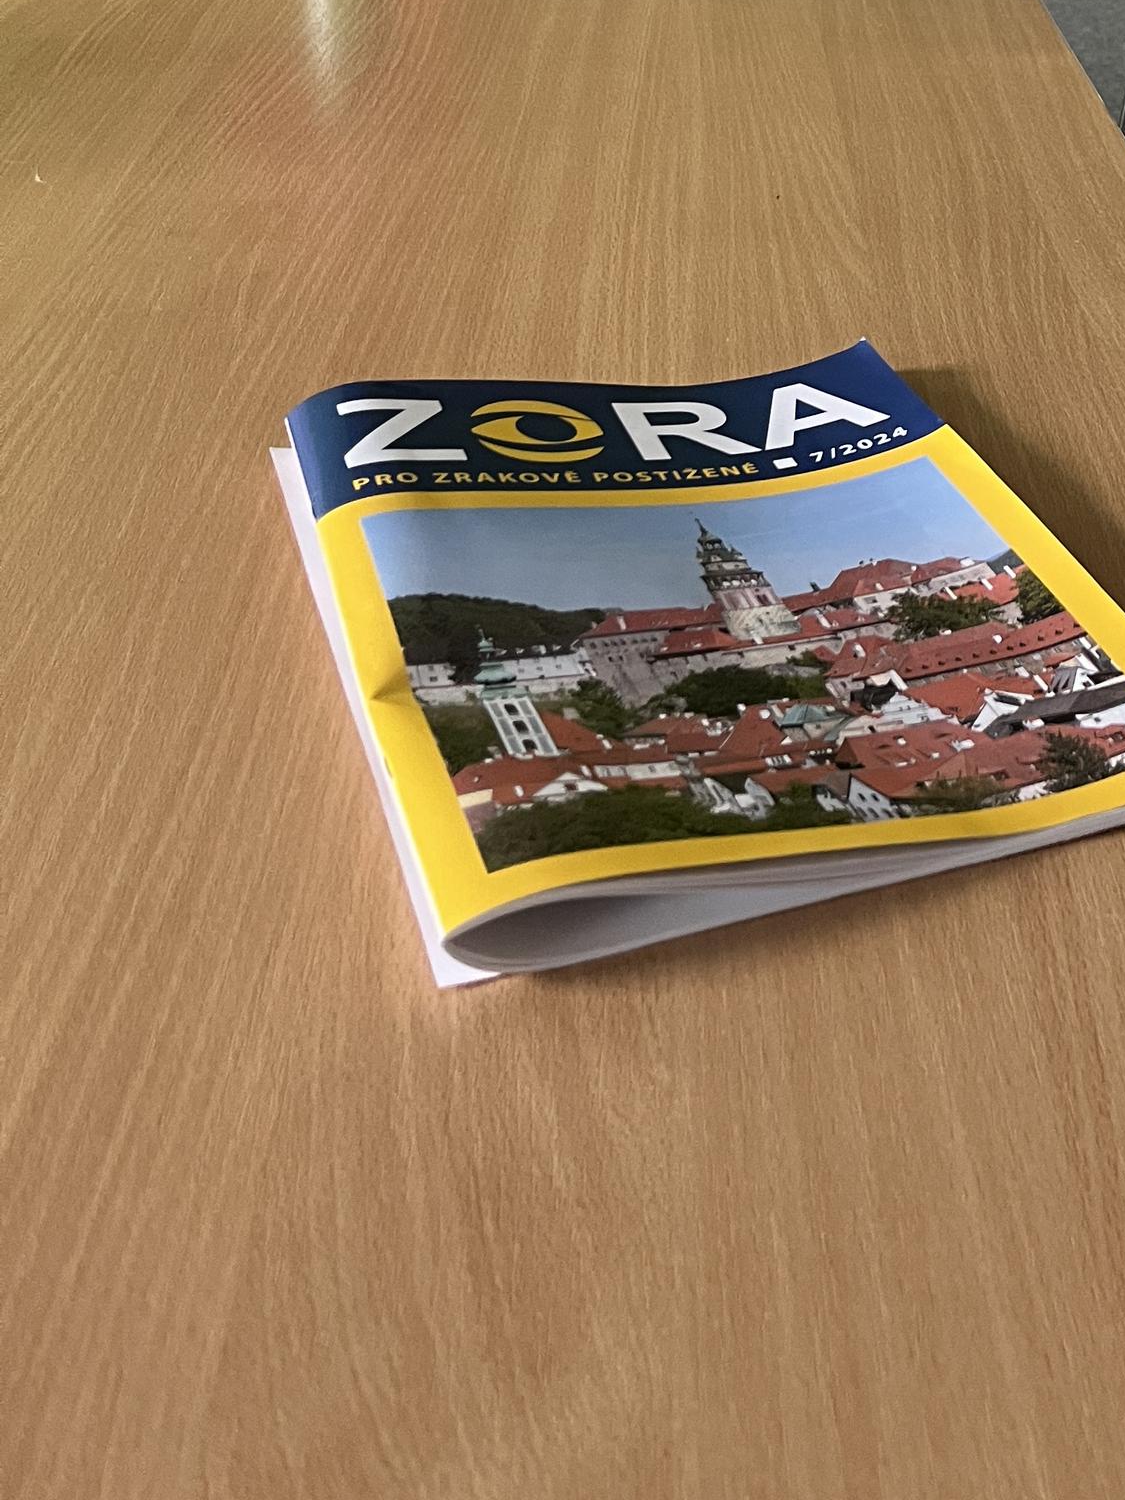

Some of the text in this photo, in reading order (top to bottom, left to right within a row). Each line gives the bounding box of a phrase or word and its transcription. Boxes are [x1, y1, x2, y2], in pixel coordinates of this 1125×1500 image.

[336, 382, 891, 469] ZORA
[351, 471, 419, 491] PRO
[592, 461, 760, 484] POSTIŽENÉ
[808, 425, 909, 463] 7/2024
